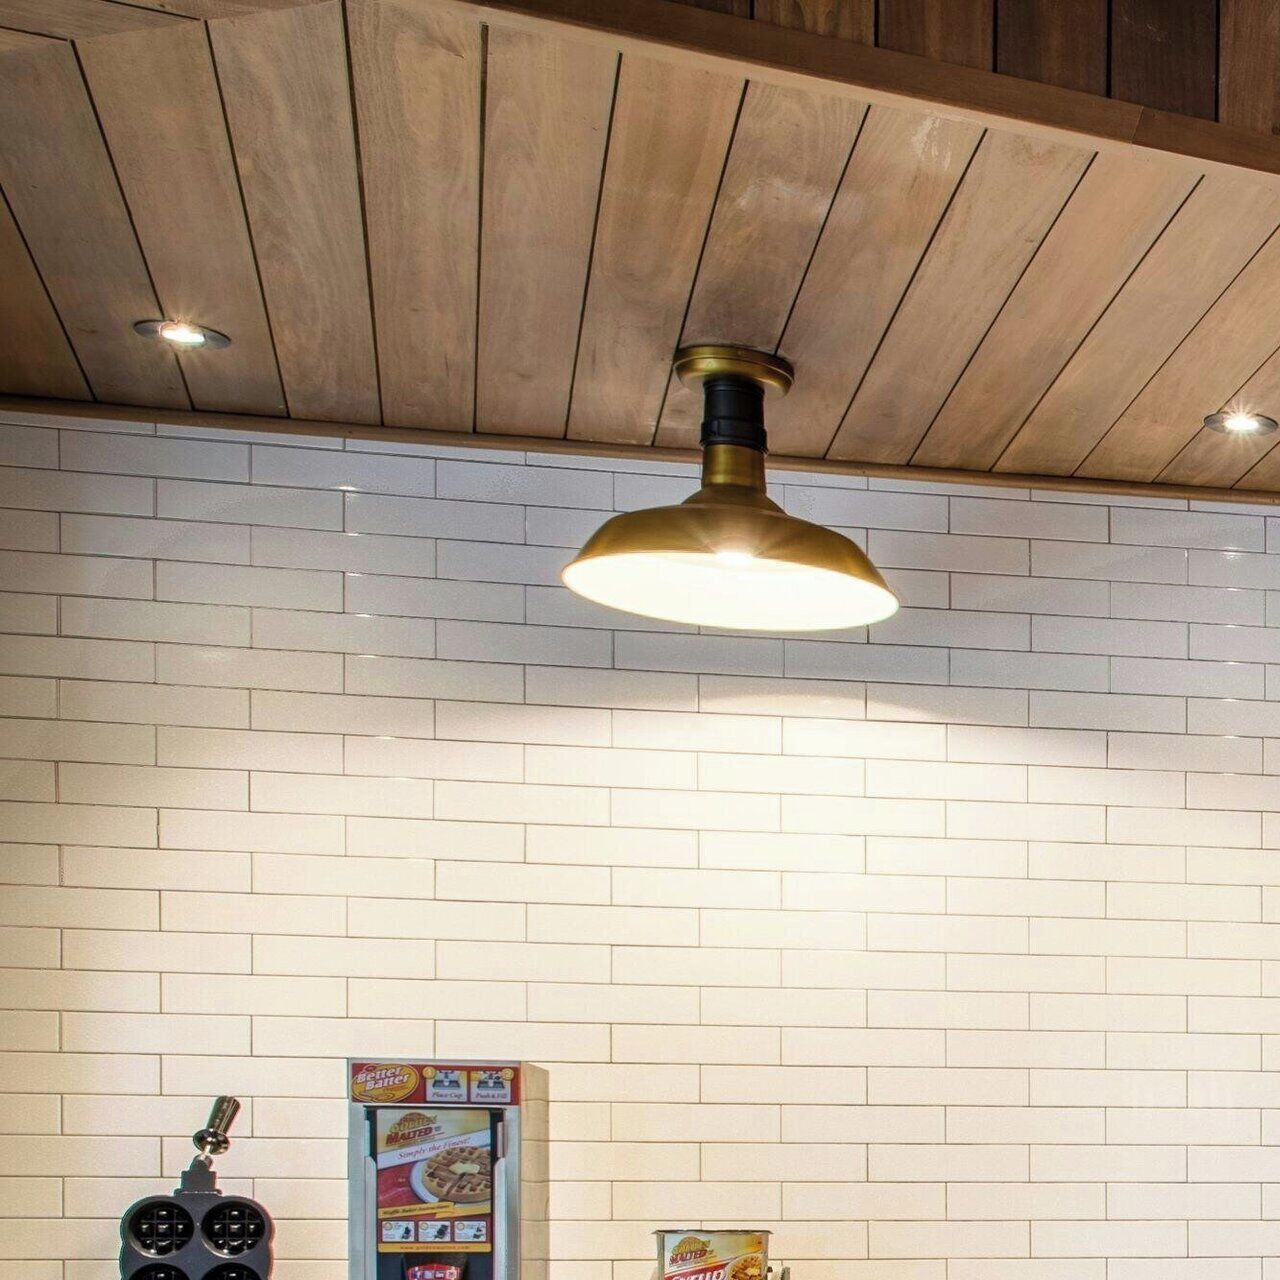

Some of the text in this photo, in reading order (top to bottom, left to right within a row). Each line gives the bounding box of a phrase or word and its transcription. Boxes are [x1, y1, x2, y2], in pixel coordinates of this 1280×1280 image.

[356, 1067, 402, 1084] Better
[386, 1127, 433, 1144] MALTED
[398, 1147, 426, 1160] Simply
[428, 1144, 441, 1152] the
